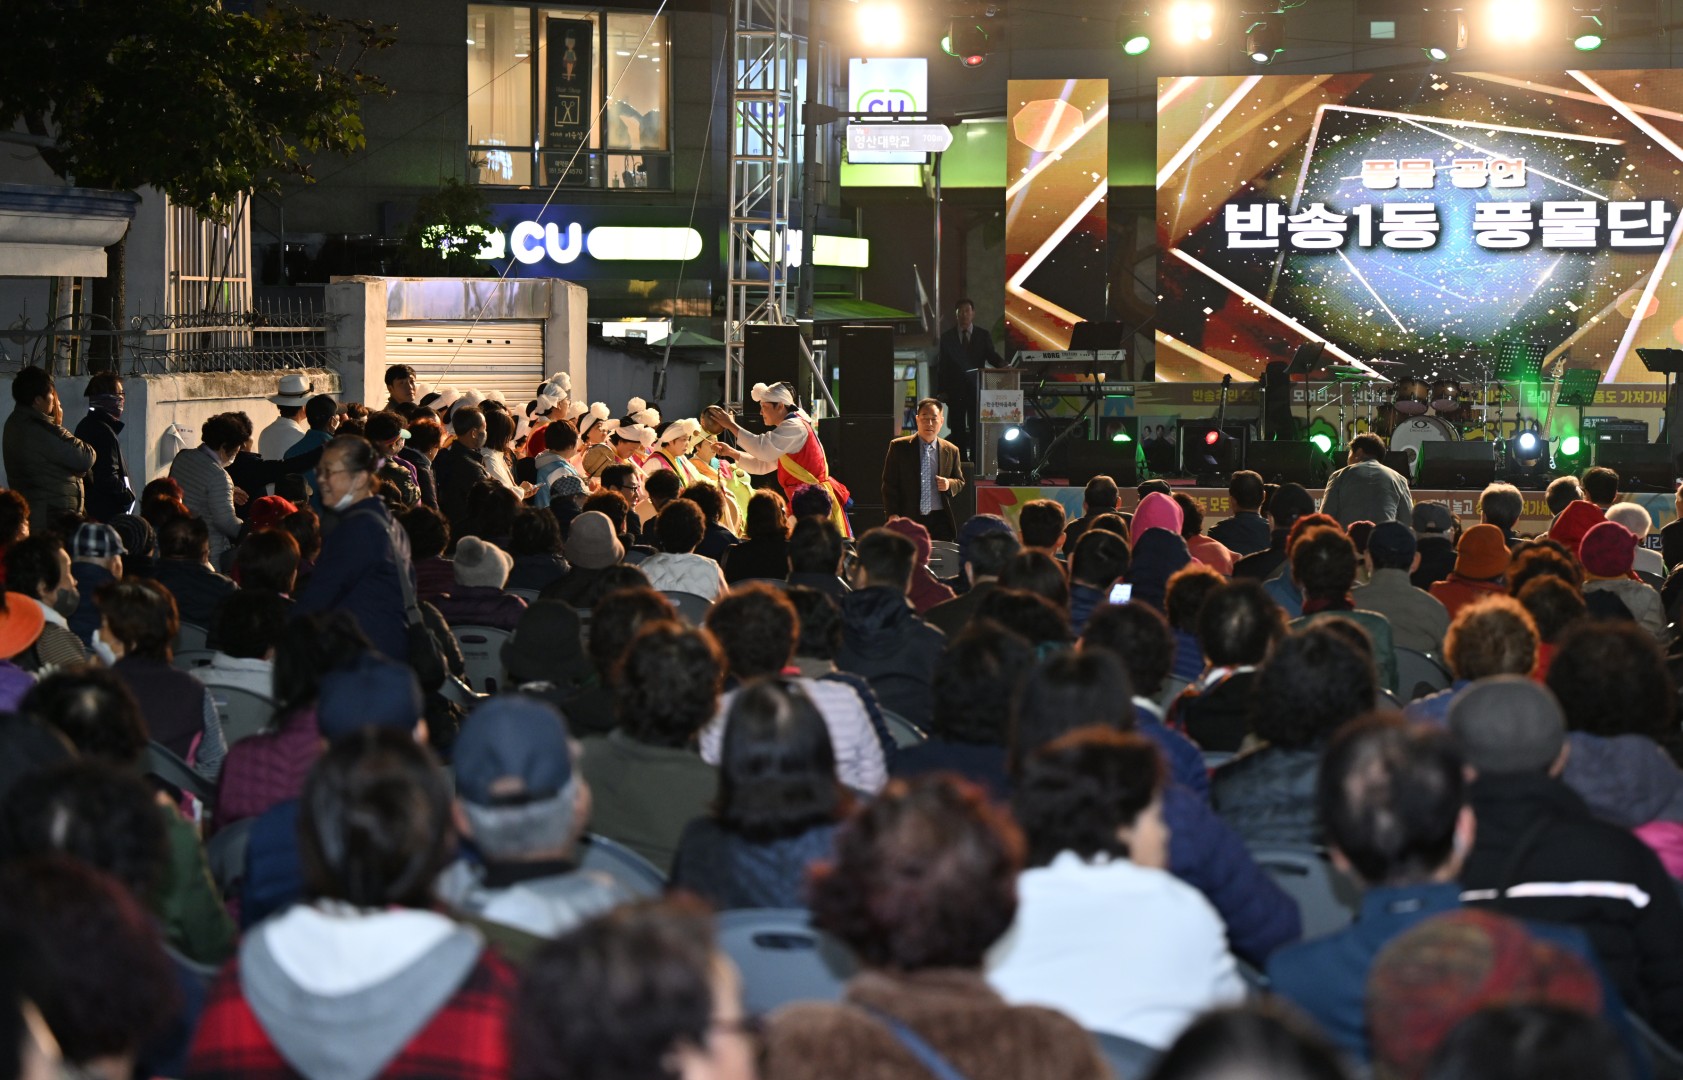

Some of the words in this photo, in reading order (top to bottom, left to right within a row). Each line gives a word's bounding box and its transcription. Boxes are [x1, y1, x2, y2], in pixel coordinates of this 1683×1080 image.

[854, 135, 910, 149] 영산대학교
[923, 134, 943, 142] 700m
[1361, 159, 1435, 188] 풍물
[1450, 157, 1526, 188] 공연
[510, 220, 582, 264] CU
[1225, 202, 1440, 249] 반송1동
[1473, 201, 1671, 249] 풍물단
